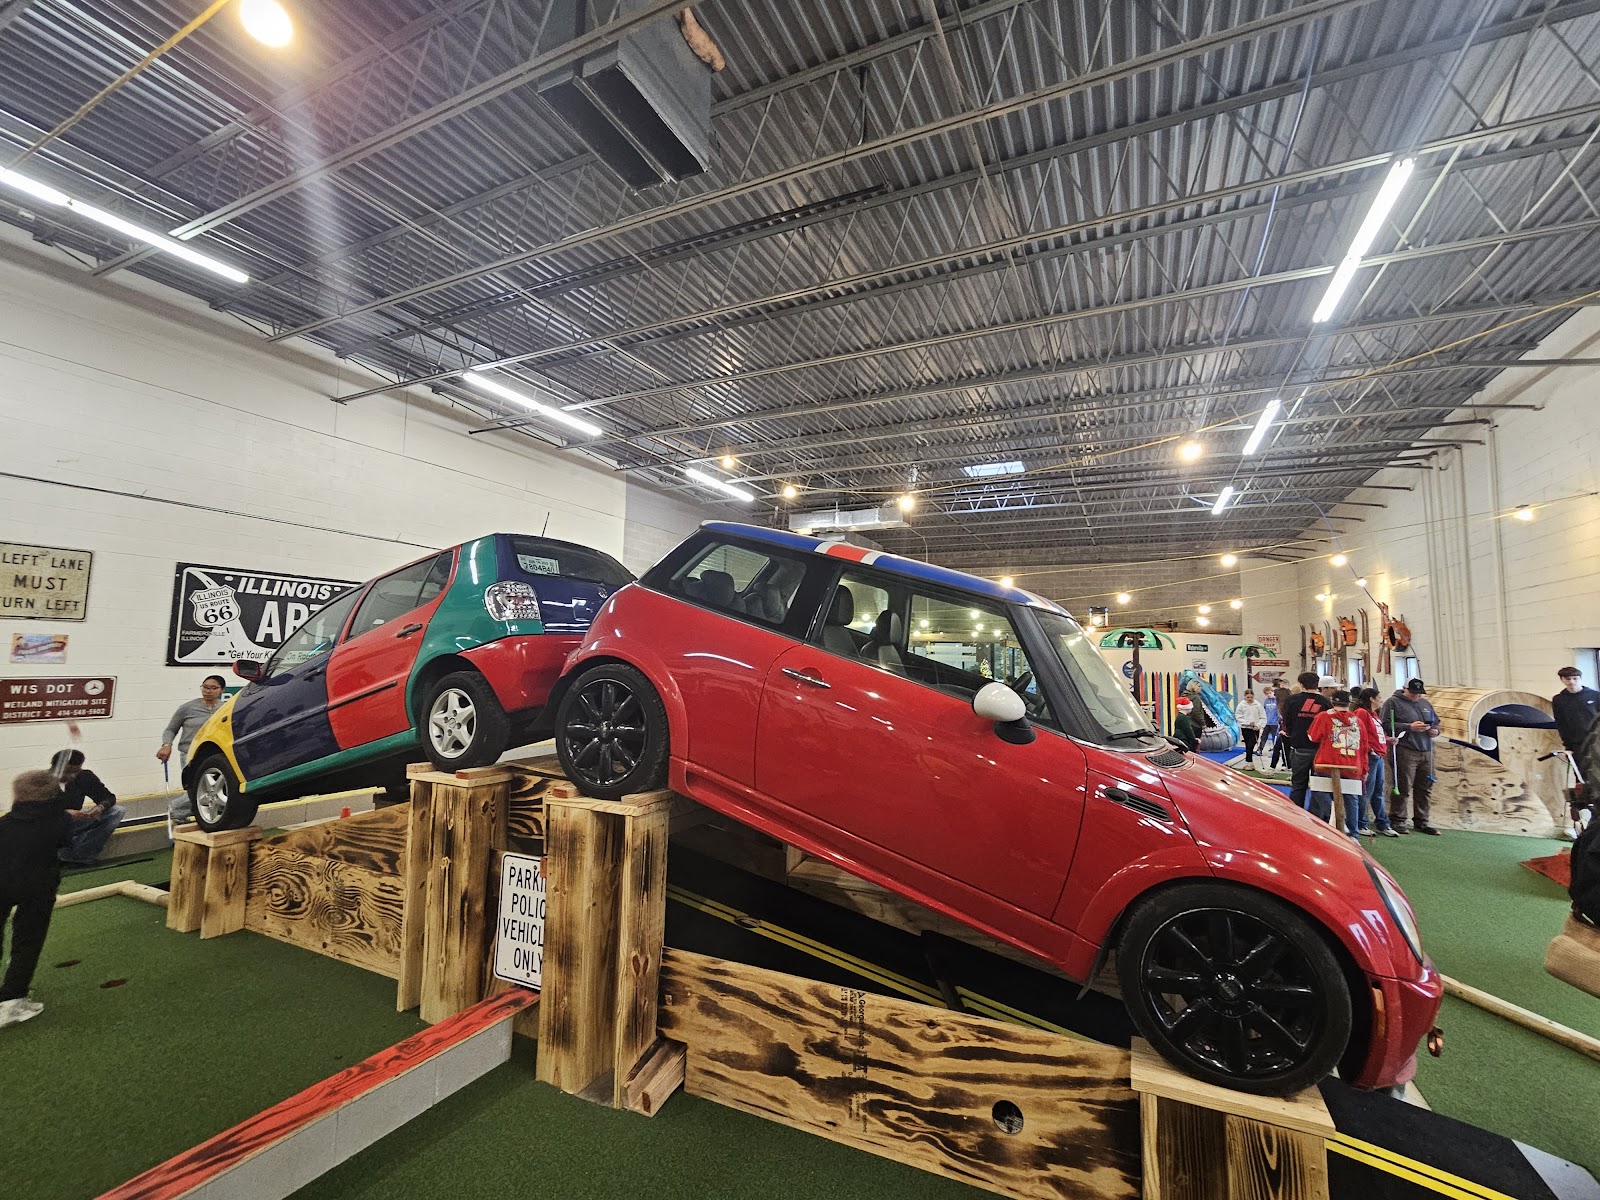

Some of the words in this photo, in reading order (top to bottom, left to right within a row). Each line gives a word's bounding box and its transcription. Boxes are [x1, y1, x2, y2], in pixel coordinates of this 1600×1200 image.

[2, 553, 39, 566] LEFT
[51, 557, 84, 571] LANE
[13, 574, 67, 591] MUST
[237, 577, 332, 600] ILLINOIS
[0, 596, 35, 609] URN
[46, 599, 80, 611] LEFT
[196, 589, 229, 601] ILLINOIS
[210, 599, 230, 607] ROUTE
[204, 605, 232, 623] 66
[246, 650, 264, 659] Your
[10, 684, 38, 694] WIS
[46, 684, 74, 694] DOT
[46, 699, 89, 707] MITIGATION
[3, 711, 42, 719] DISTRICT
[508, 866, 546, 893] PARKI
[511, 893, 546, 920] POLIC
[503, 917, 544, 947] VEHICL
[513, 947, 543, 974] ONLY
